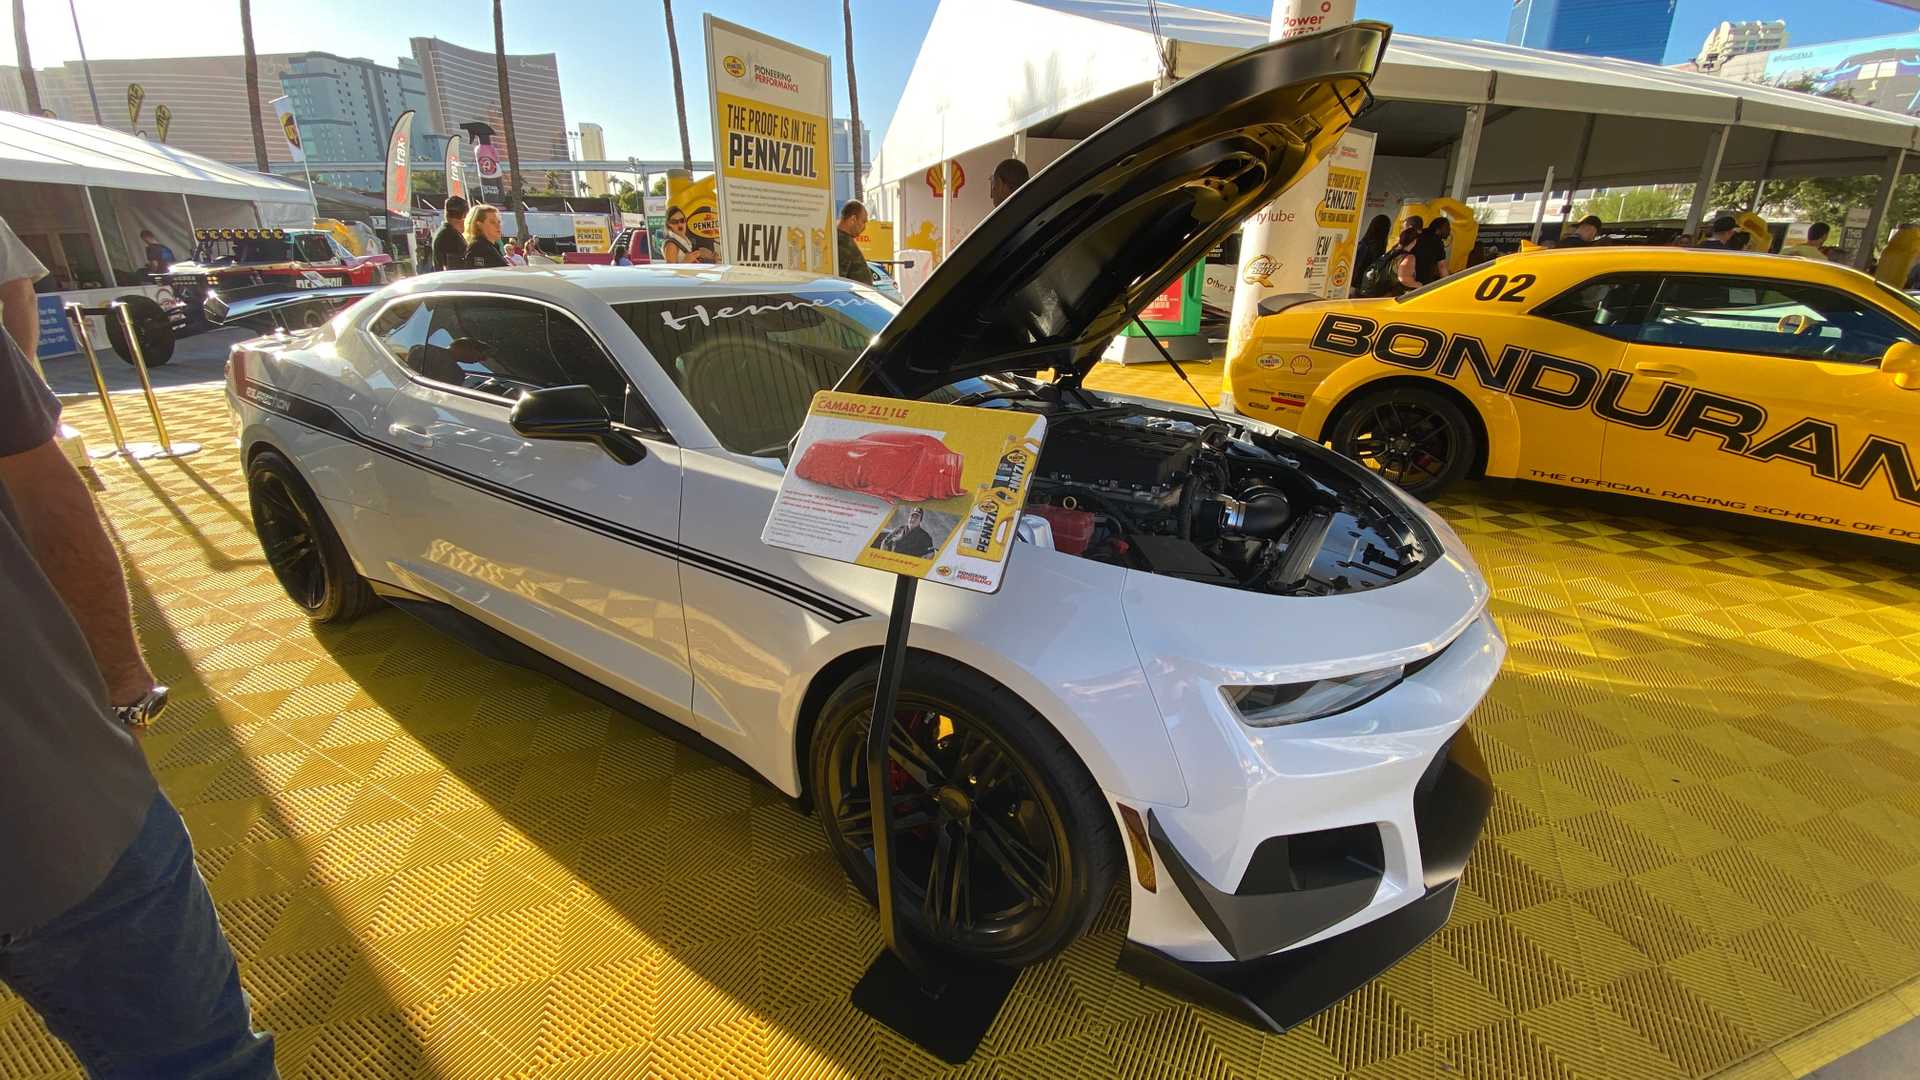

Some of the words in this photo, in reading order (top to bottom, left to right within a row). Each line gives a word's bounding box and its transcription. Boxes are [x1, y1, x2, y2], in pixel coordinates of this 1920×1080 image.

[1284, 15, 1325, 27] Power
[754, 64, 792, 83] PIONEERING
[755, 73, 800, 94] PERFORMANCE
[727, 104, 746, 131] THE
[748, 109, 779, 136] PROOF
[780, 115, 790, 139] IS
[791, 118, 800, 141] IN
[802, 121, 817, 144] THE
[728, 131, 818, 179] PENNZOIL
[1268, 209, 1295, 222] lube
[737, 223, 782, 262] NEW
[1206, 277, 1227, 291] Other
[1474, 273, 1537, 302] 02
[817, 400, 866, 413] CAMARO
[1529, 469, 1568, 480] THE
[1570, 476, 1657, 495] OFFICIAL
[1661, 490, 1746, 510] RACING
[1753, 505, 1848, 527] SCHOOL
[1852, 522, 1886, 532] OF
